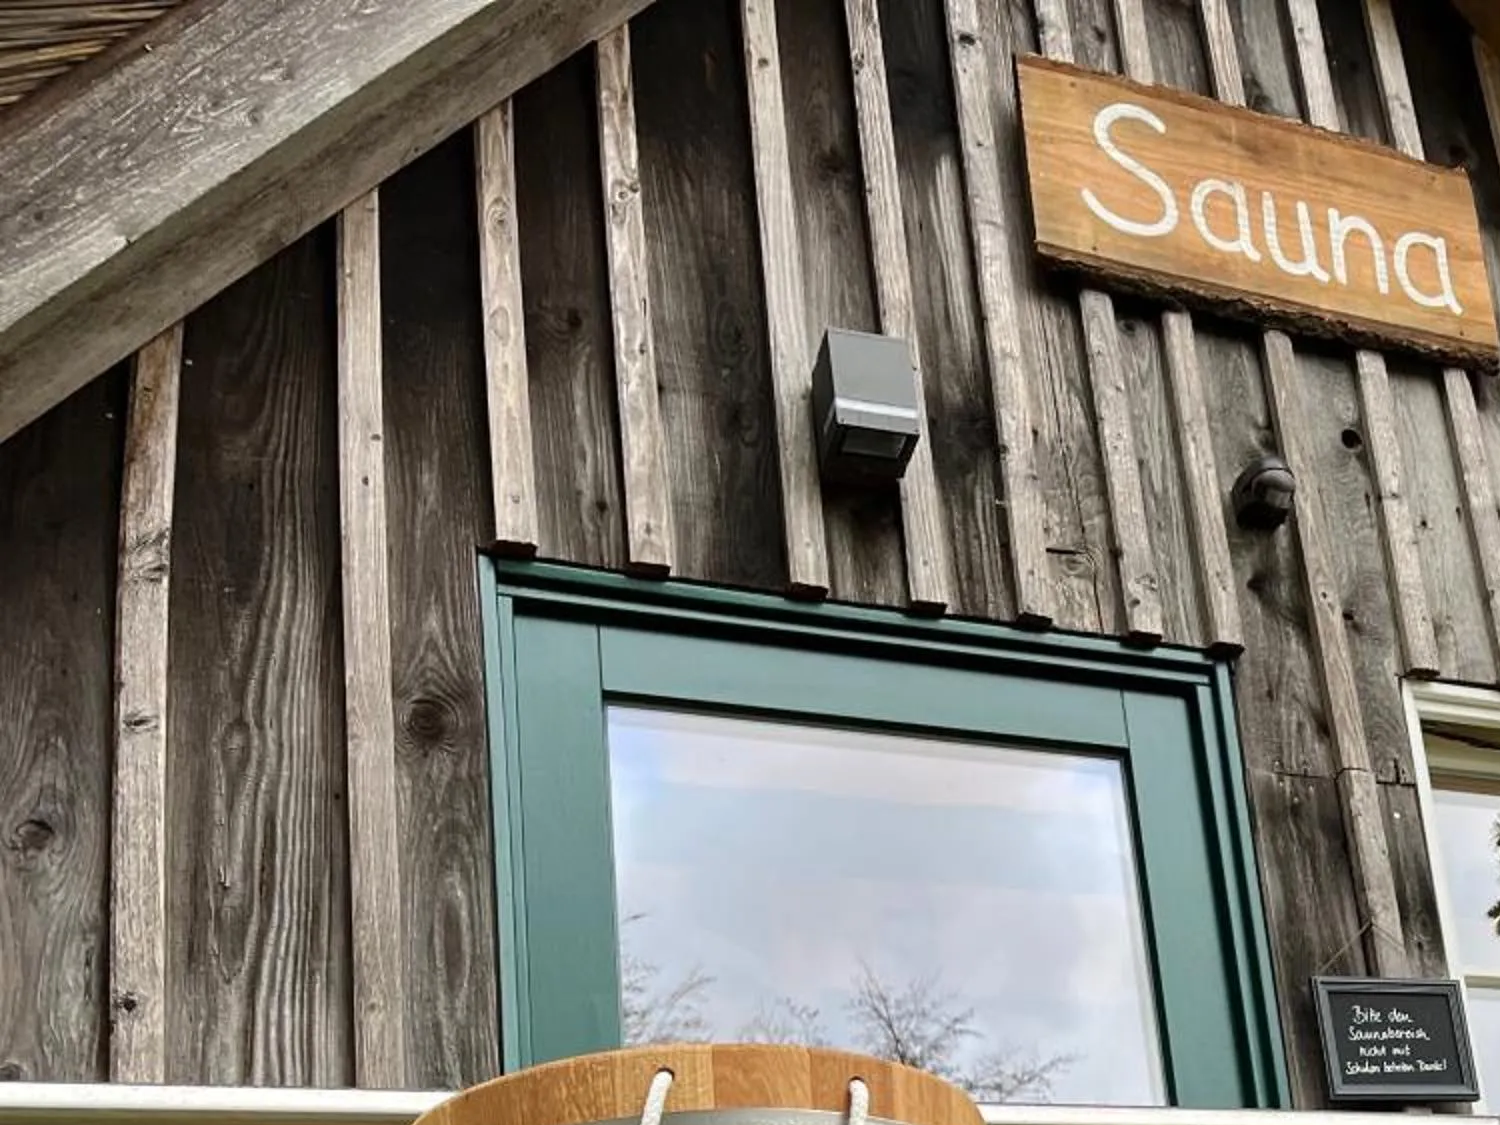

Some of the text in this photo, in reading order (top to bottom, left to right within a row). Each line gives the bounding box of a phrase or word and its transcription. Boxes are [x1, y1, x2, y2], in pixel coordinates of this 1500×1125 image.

[1081, 102, 1463, 315] Sauna
[1352, 1005, 1414, 1024] Bitte den
[1348, 1026, 1431, 1041] Saunabereich
[1359, 1044, 1411, 1057] nicht mit
